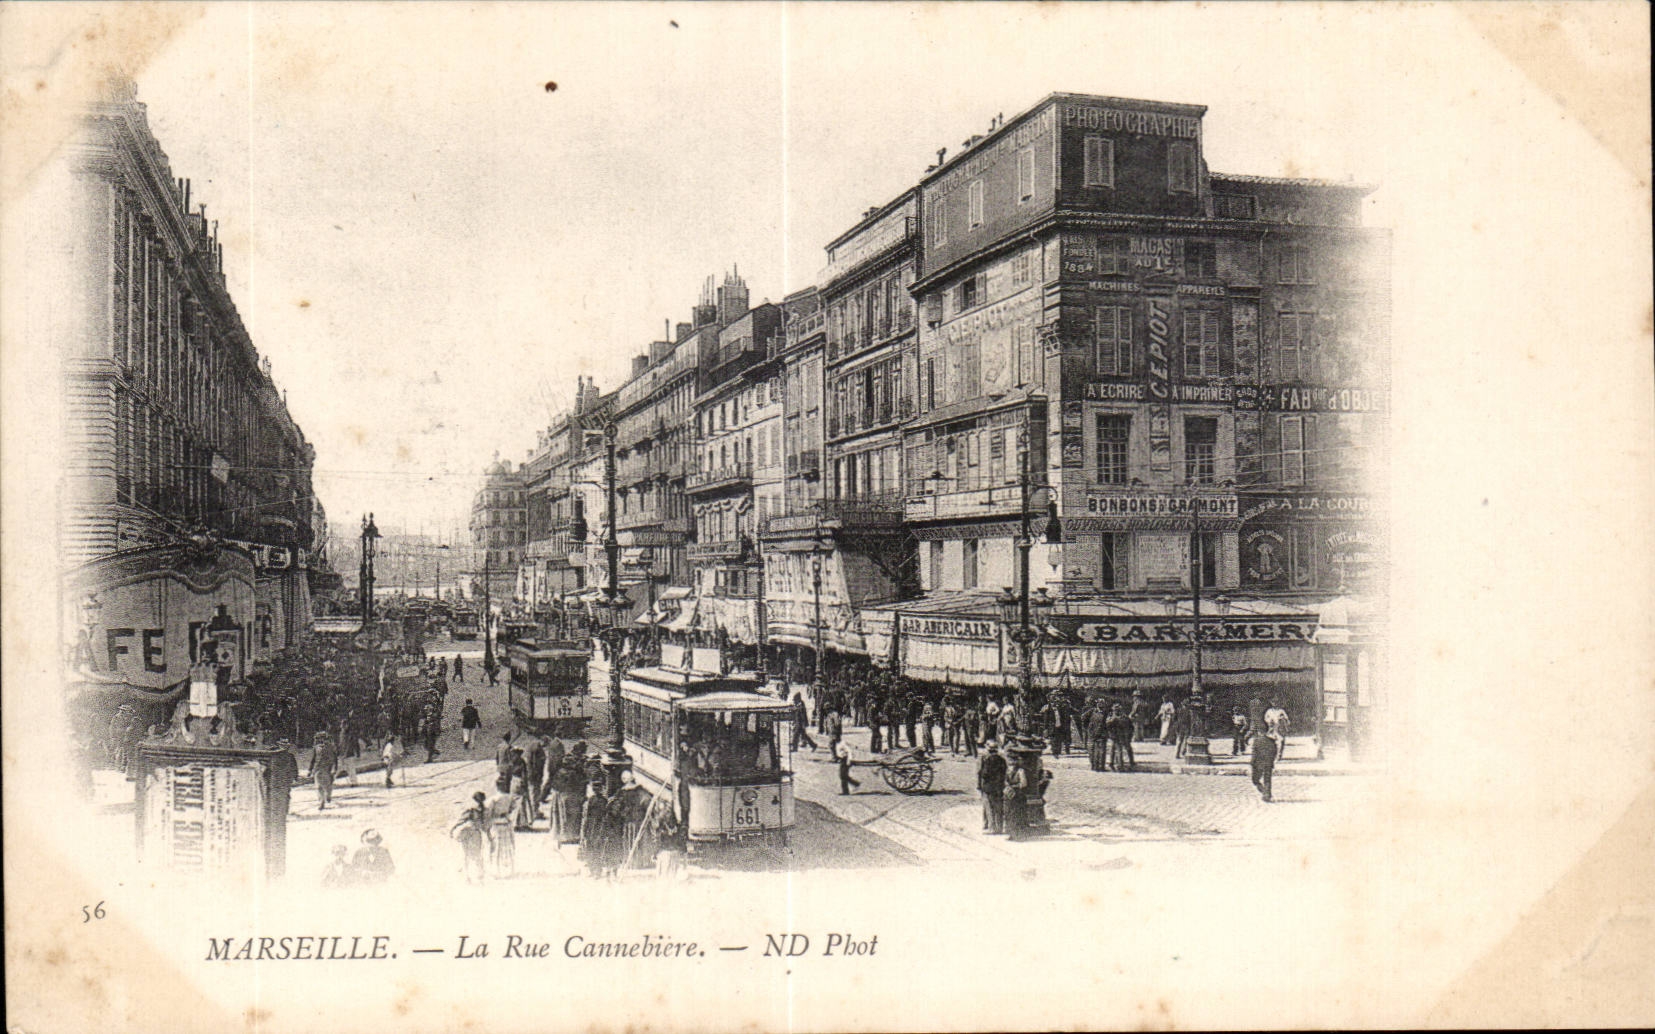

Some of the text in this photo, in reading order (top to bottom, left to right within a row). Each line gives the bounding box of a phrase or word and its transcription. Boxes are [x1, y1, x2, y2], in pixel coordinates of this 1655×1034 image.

[1065, 106, 1198, 139] PHOTOGRAPHIE
[1088, 281, 1141, 292] MACHINES
[1100, 384, 1145, 400] ECRIRE
[1182, 385, 1232, 401] IMPRIMER
[1088, 498, 1158, 512] BONBONS
[1280, 498, 1293, 510] A
[1298, 498, 1320, 510] LA
[902, 618, 991, 637] BAR AMERICAIN
[1093, 624, 1183, 641] BAR
[736, 807, 760, 825] 661
